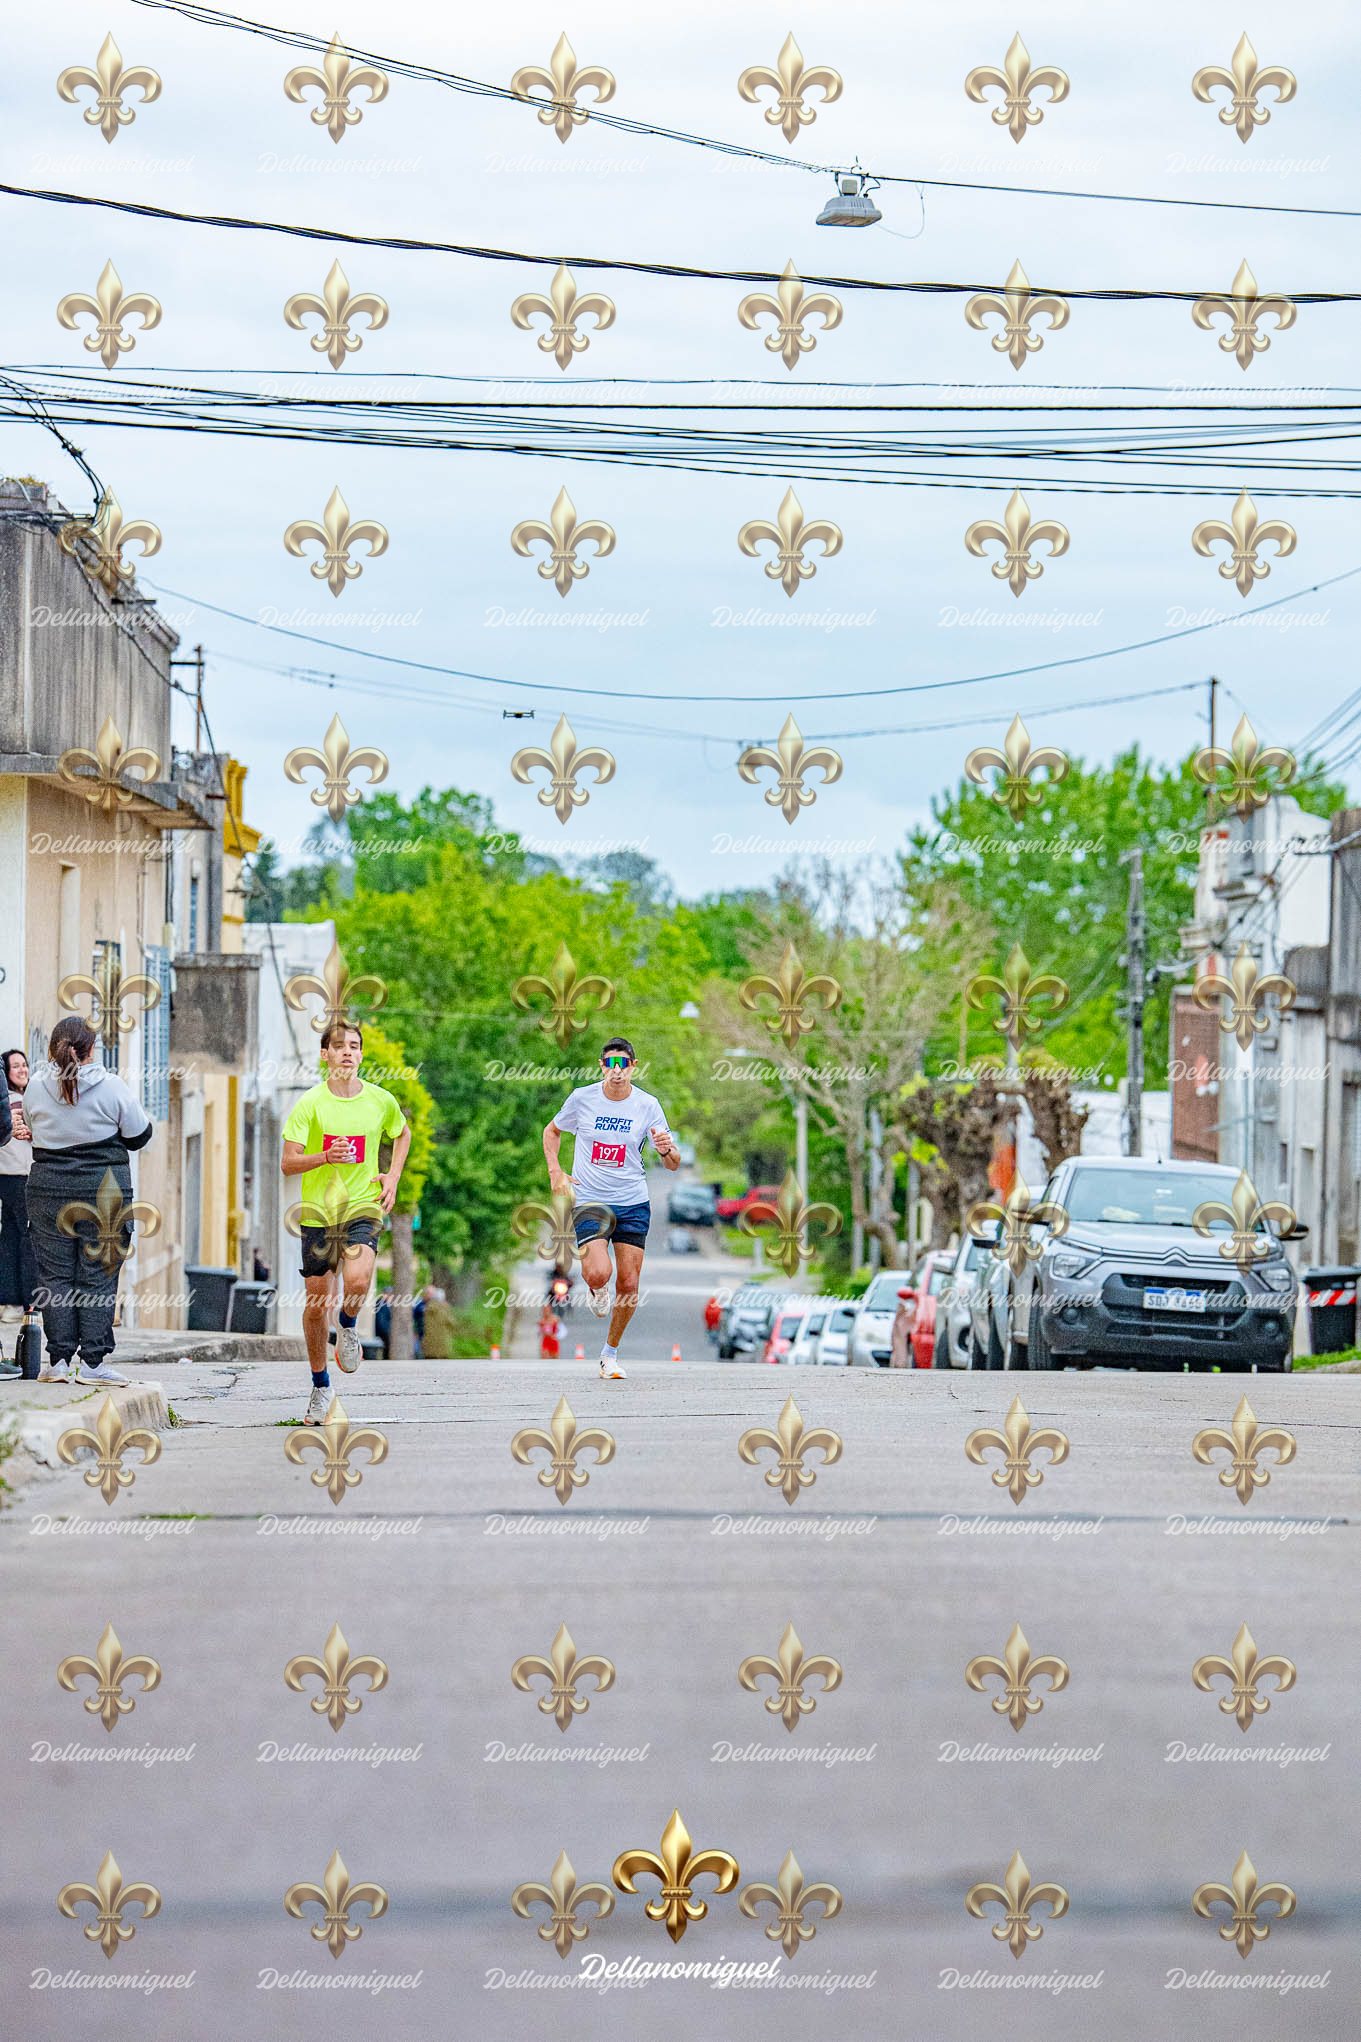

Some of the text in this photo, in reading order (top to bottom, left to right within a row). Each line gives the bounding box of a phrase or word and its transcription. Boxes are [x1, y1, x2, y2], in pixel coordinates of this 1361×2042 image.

[595, 1116, 634, 1126] PROFIT
[594, 1123, 619, 1132] RUN
[598, 1146, 620, 1160] 197
